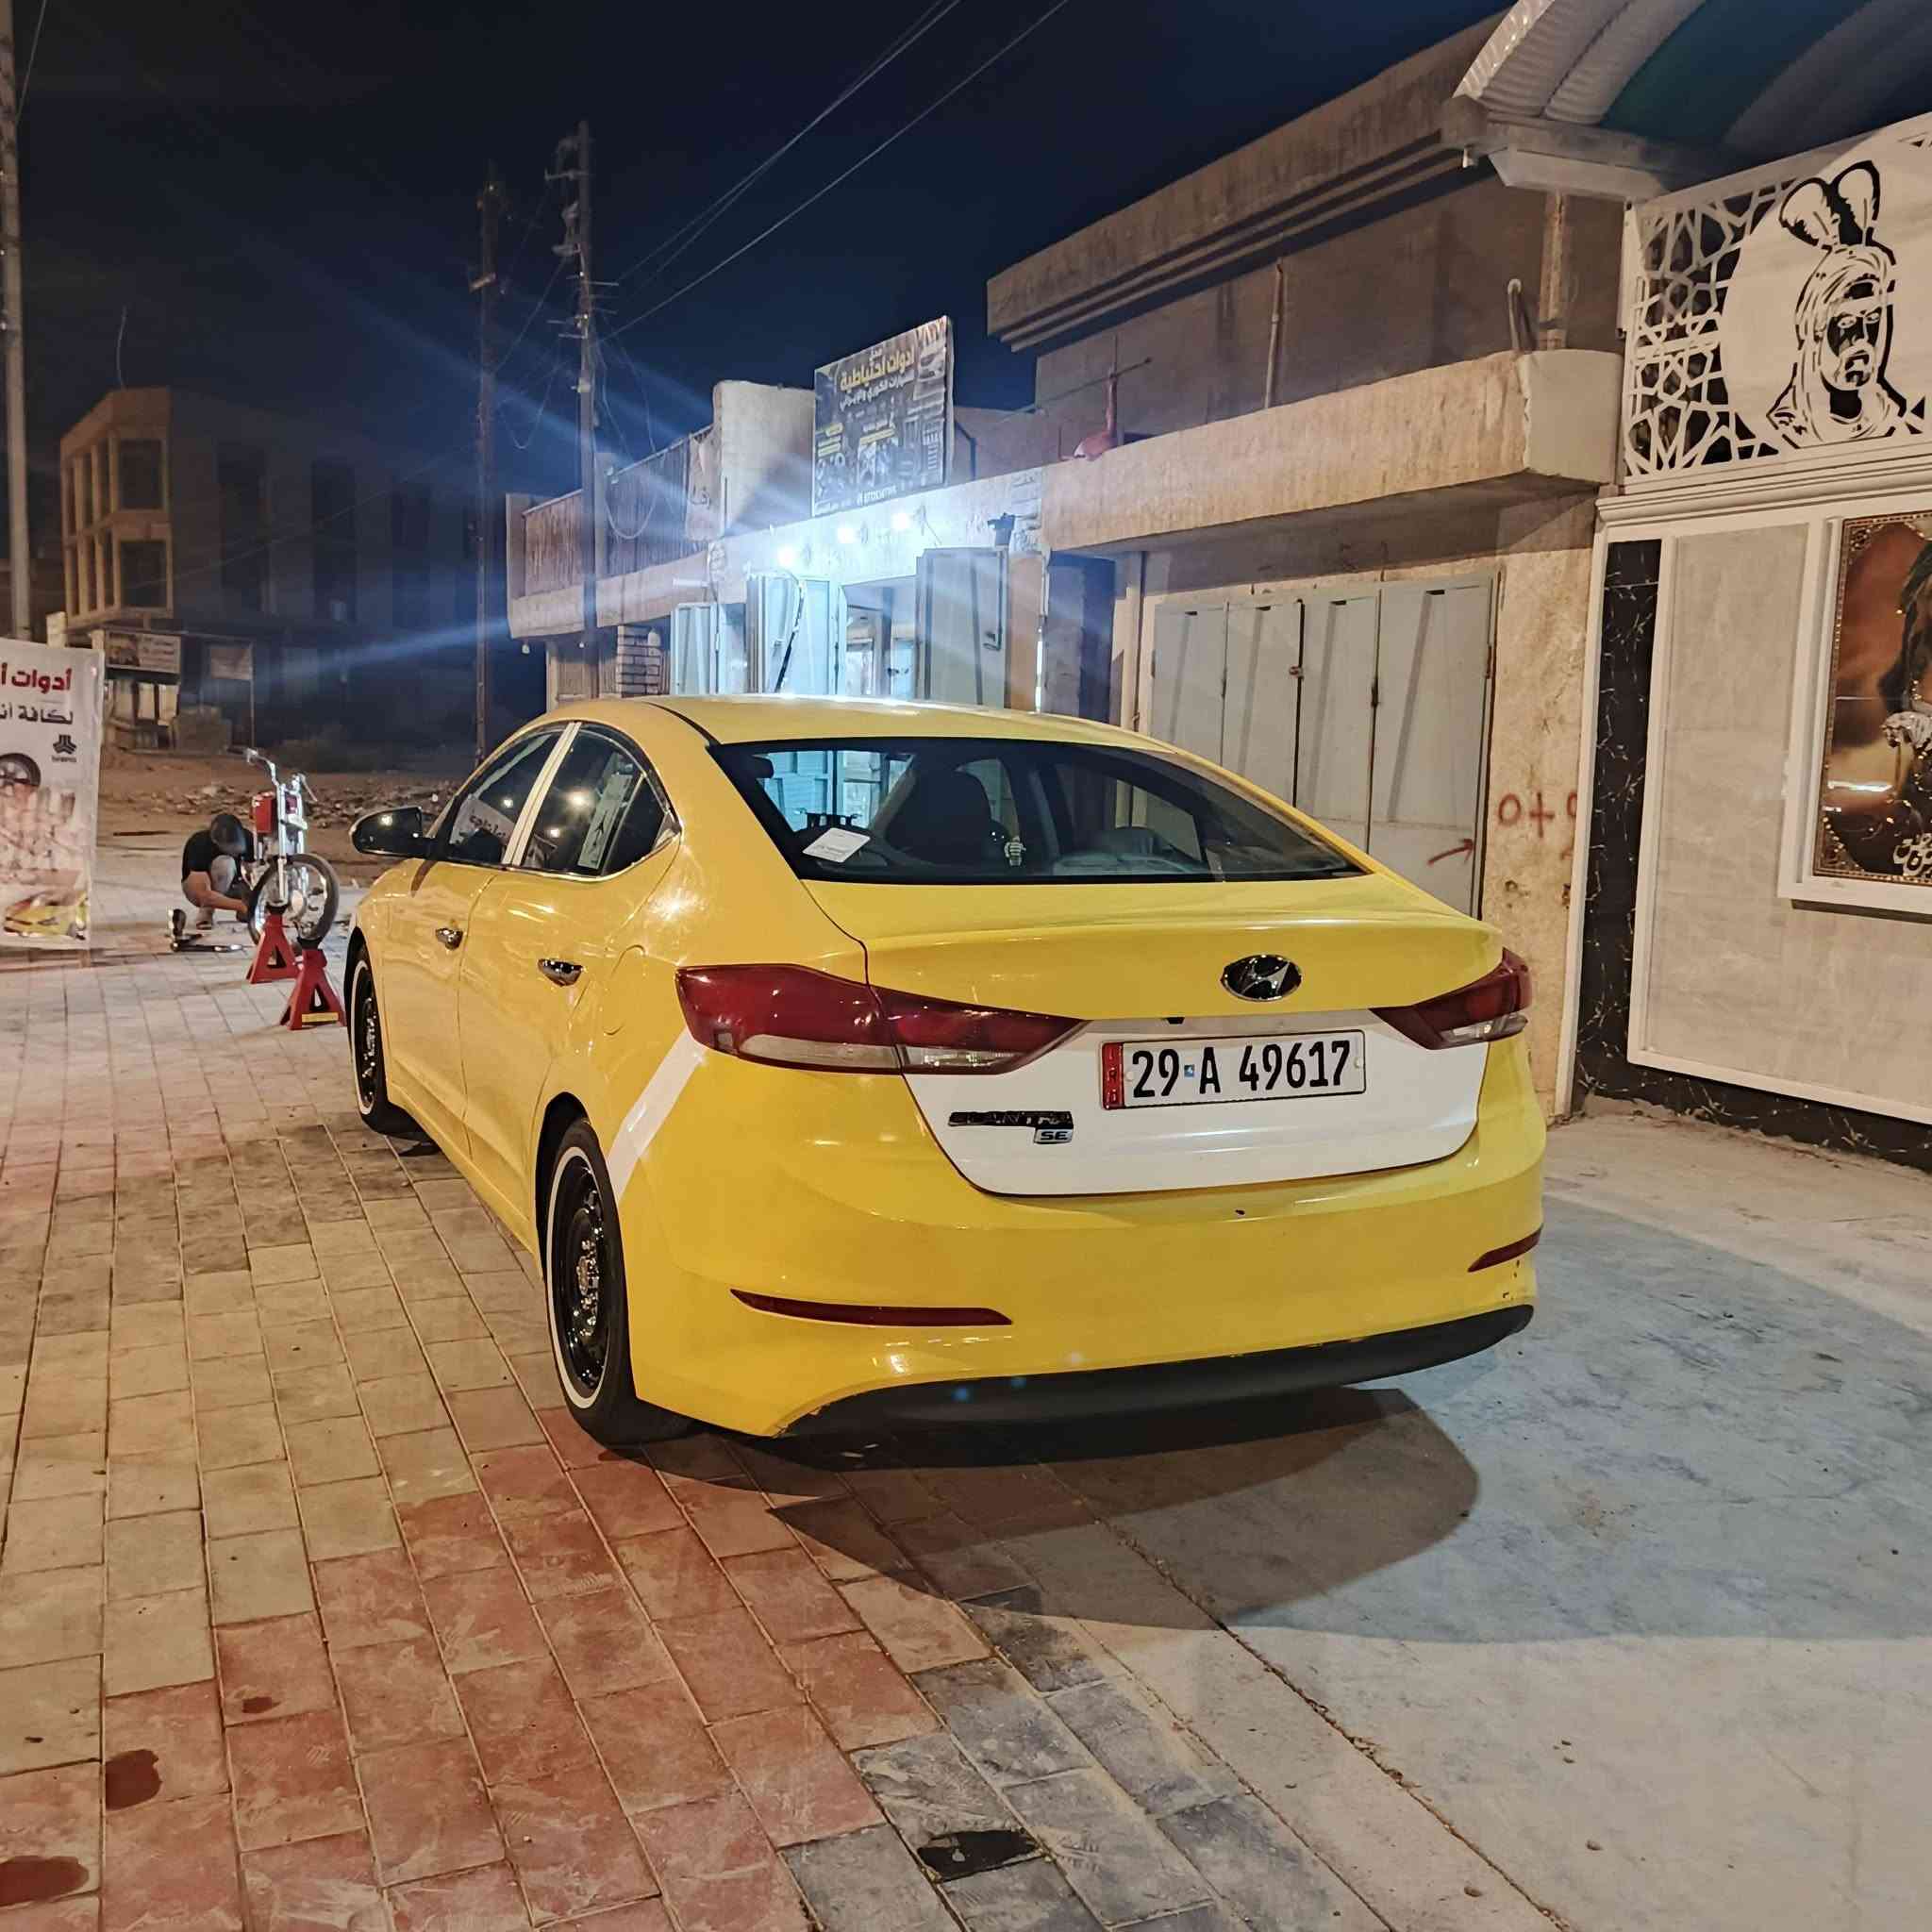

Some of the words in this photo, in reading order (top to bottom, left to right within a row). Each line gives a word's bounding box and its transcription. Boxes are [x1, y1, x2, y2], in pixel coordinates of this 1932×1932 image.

[11, 667, 72, 694] أدوات
[18, 705, 73, 724] لكافة
[1132, 1049, 1179, 1097] 29
[1199, 1047, 1221, 1094] A
[1239, 1041, 1350, 1091] 49617
[1040, 1130, 1068, 1141] SE
